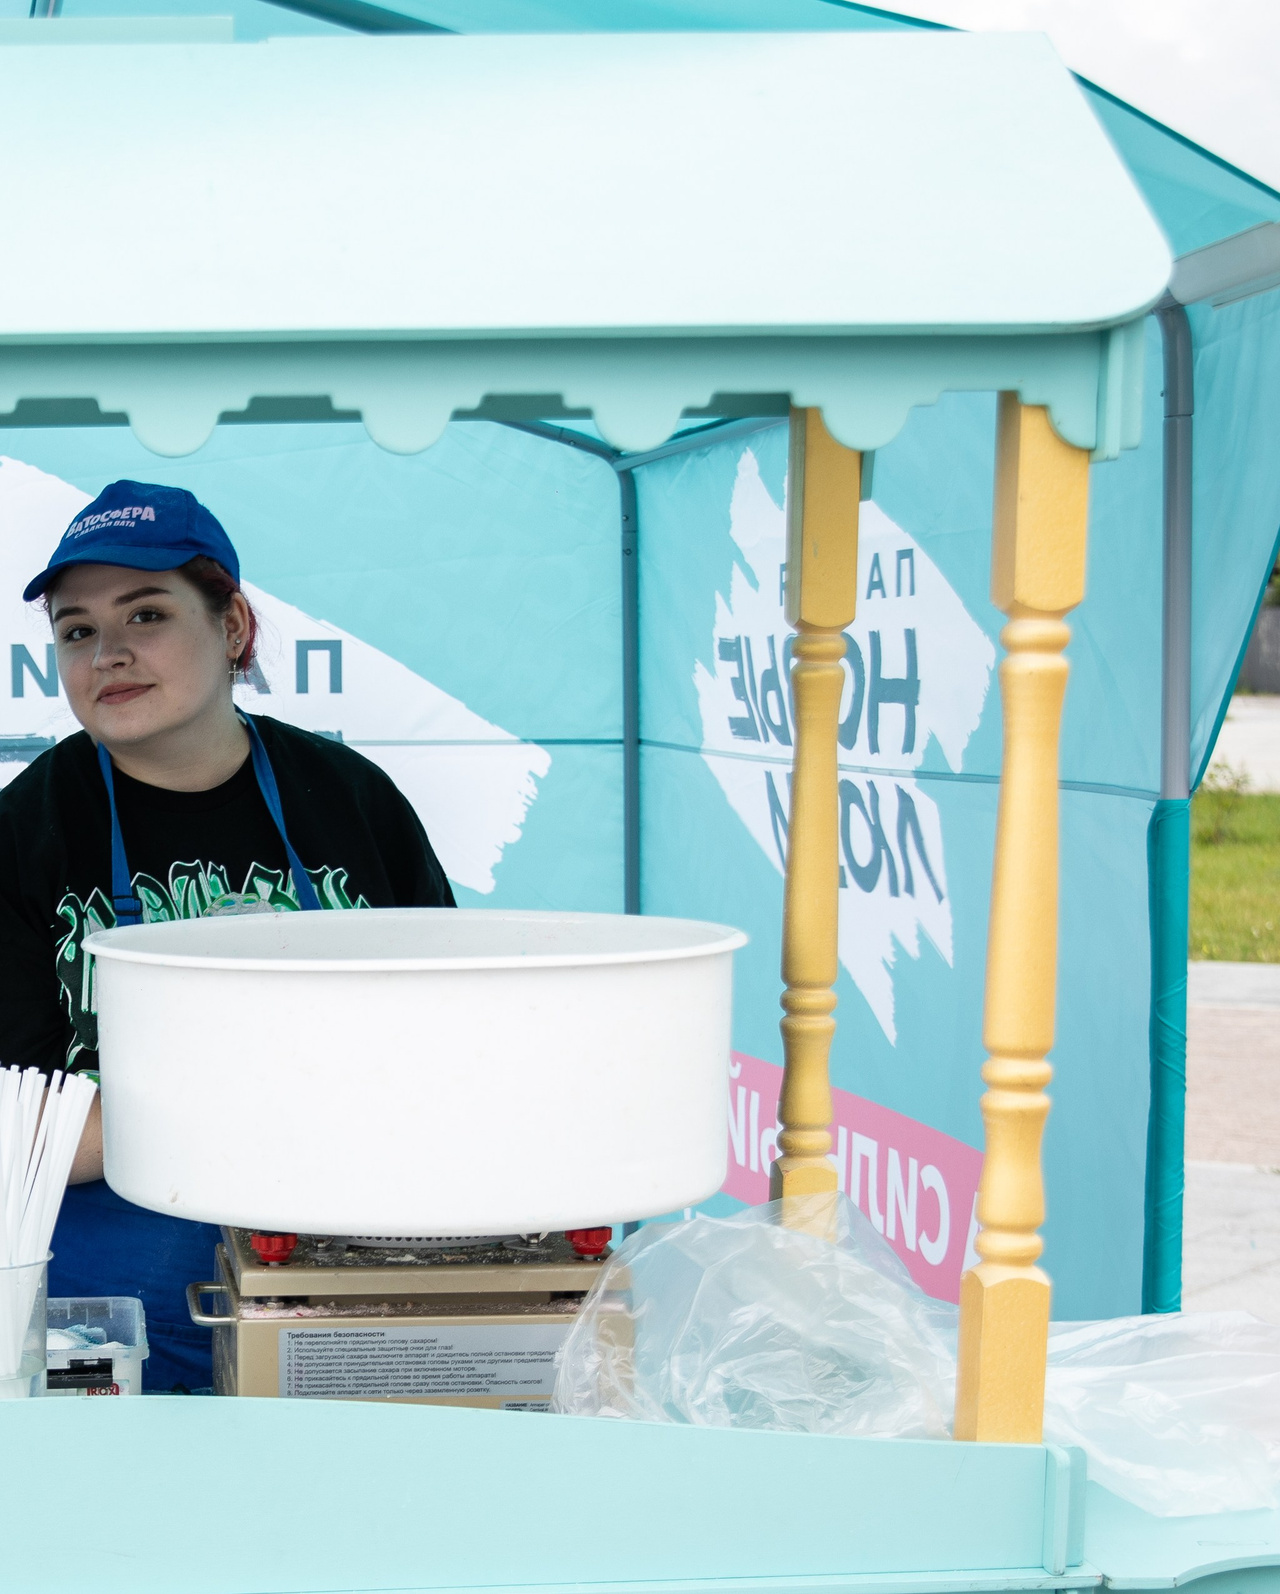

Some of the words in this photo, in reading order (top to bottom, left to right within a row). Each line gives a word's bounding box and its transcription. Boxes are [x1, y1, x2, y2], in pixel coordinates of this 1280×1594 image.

[65, 506, 156, 539] ВАТОСФЕРА
[74, 520, 113, 539] СЛАДКАЯ
[113, 520, 136, 528] ВАТА
[287, 1331, 331, 1340] Требования
[304, 1339, 347, 1347] переполняйте
[410, 1337, 438, 1345] сахаром!
[294, 1346, 333, 1354] Используйте
[315, 1353, 345, 1361] загрузкой
[514, 1356, 554, 1364] предметами!
[304, 1375, 346, 1383] прикасайтесь
[352, 1374, 389, 1382] прядильной
[442, 1372, 465, 1380] работы
[466, 1372, 497, 1380] аппарата!
[304, 1382, 346, 1390] прикасайтесь
[352, 1381, 389, 1389] прядильной
[294, 1389, 335, 1397] Подключайте
